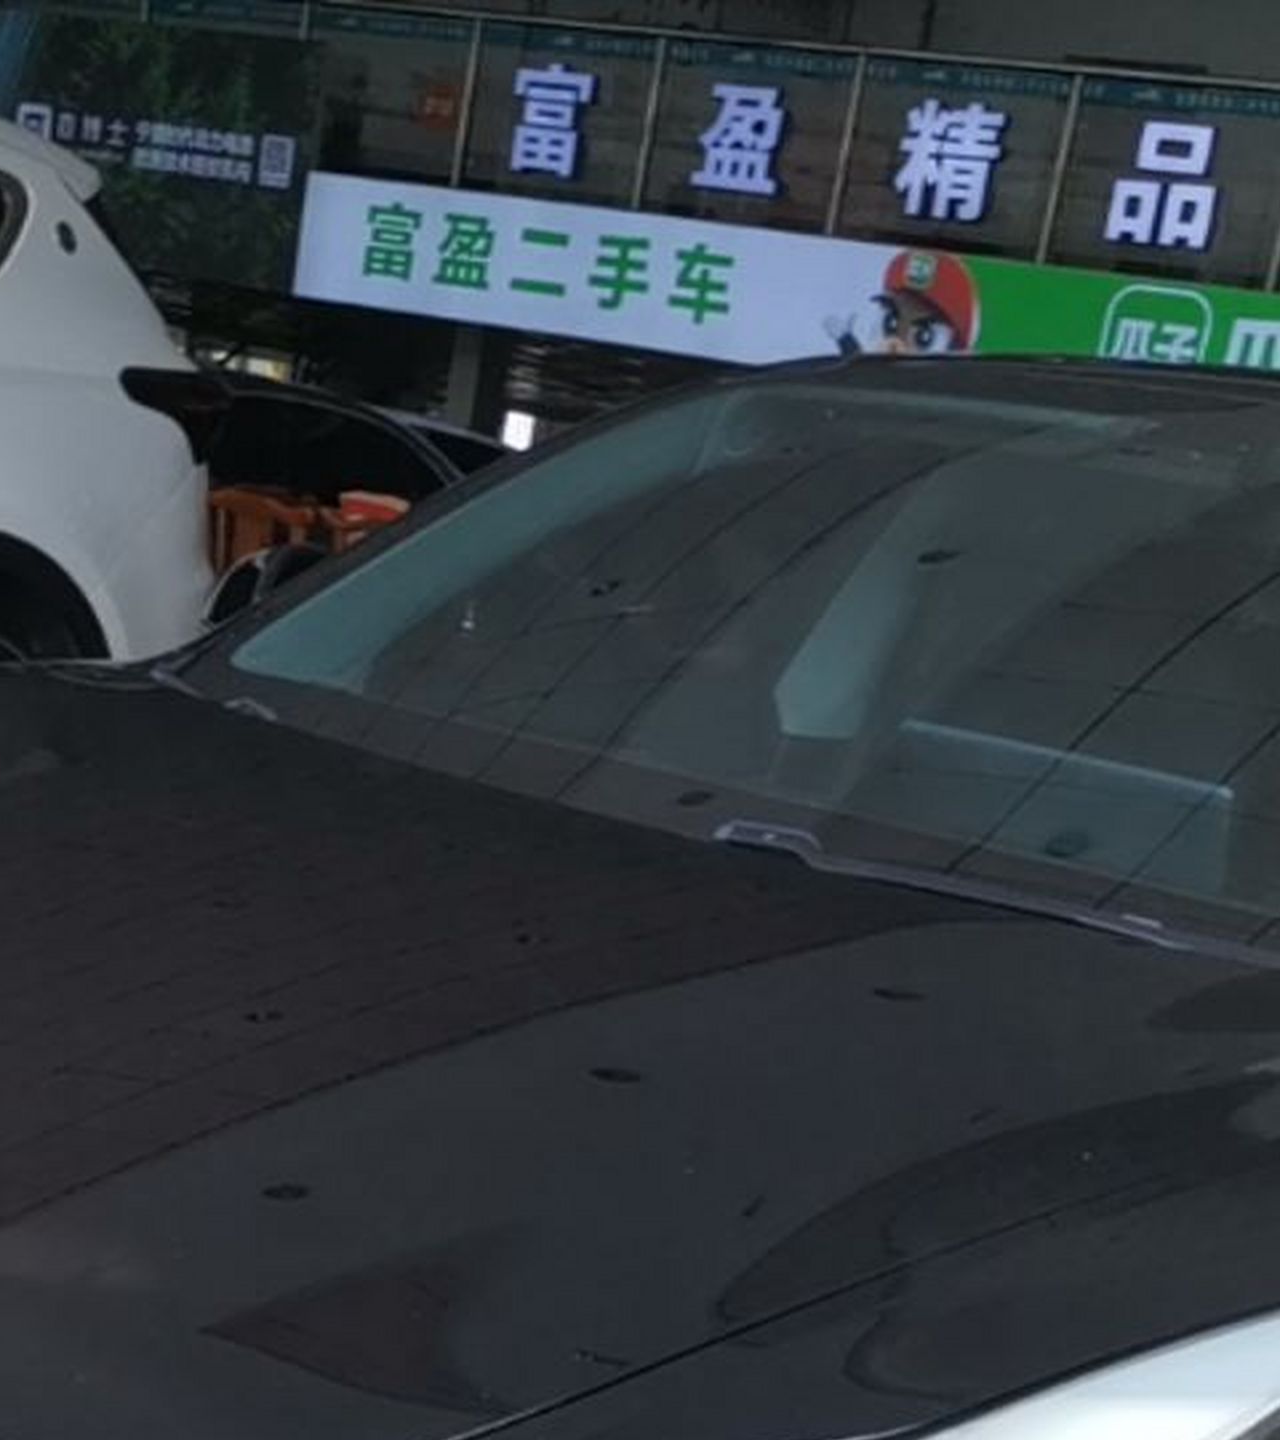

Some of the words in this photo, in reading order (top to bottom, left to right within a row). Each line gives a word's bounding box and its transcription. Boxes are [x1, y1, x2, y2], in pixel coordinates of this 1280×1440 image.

[507, 63, 1218, 250] 富盈精品
[361, 202, 736, 326] 富盈二手车
